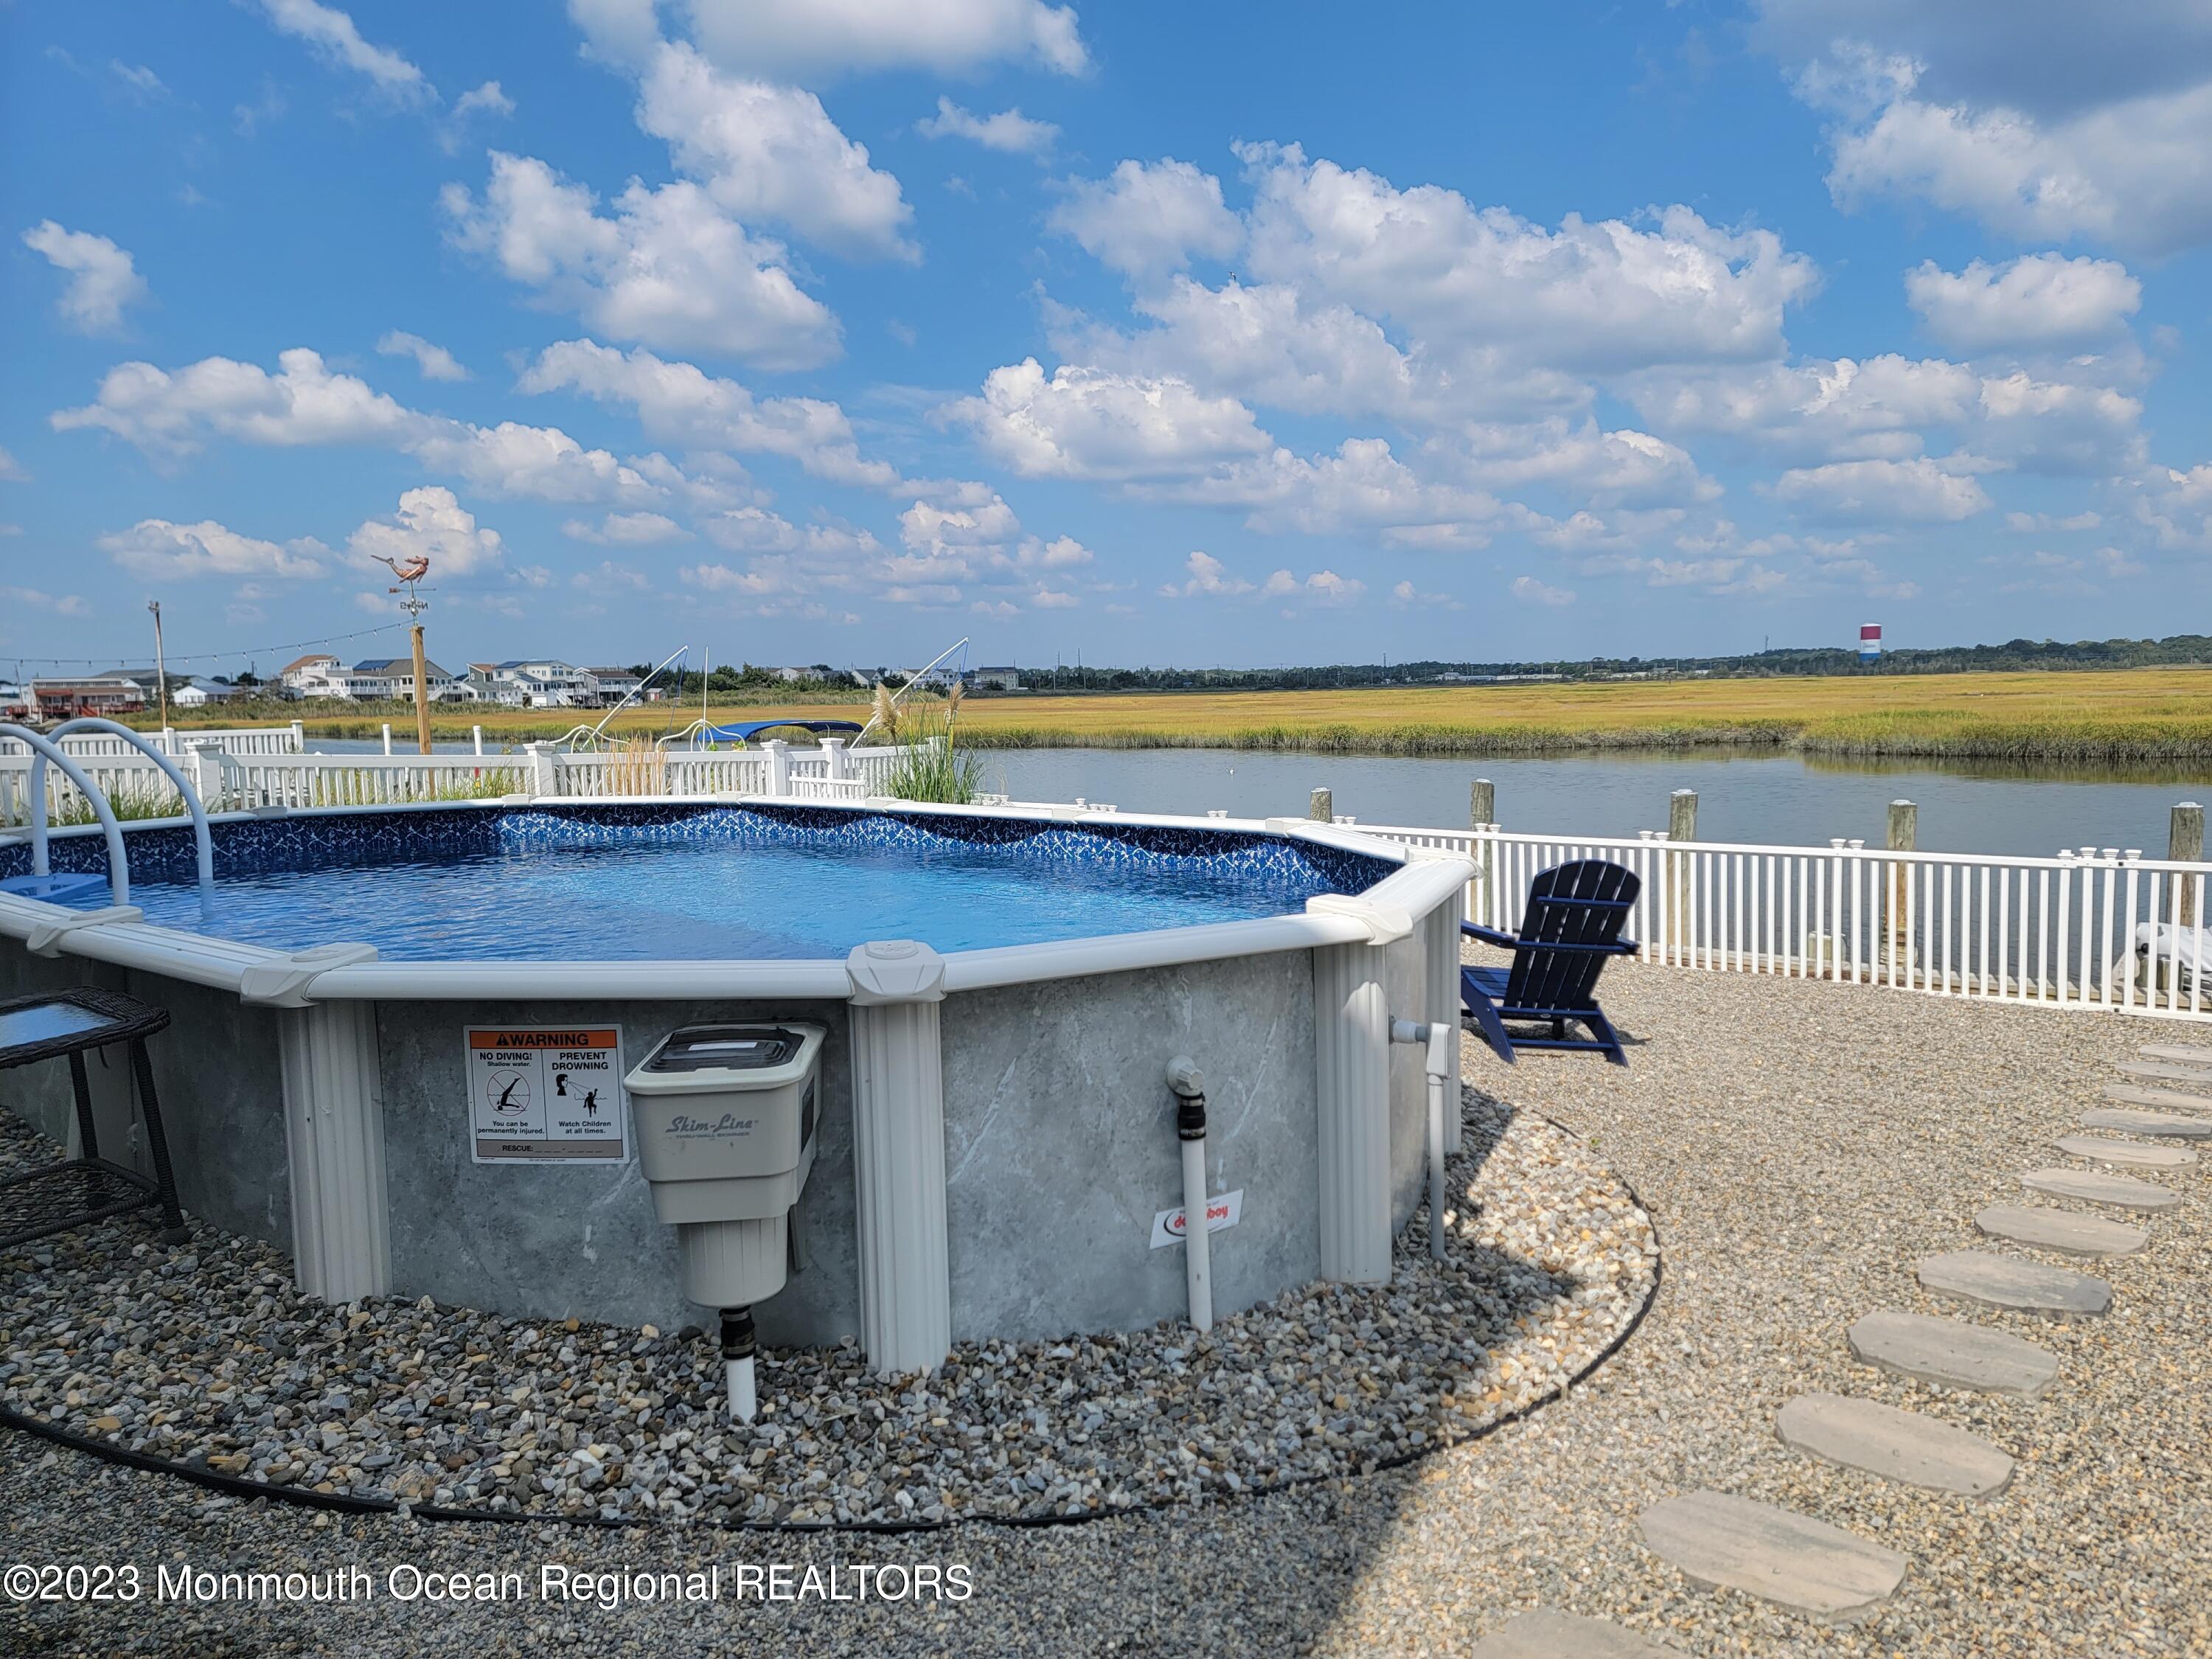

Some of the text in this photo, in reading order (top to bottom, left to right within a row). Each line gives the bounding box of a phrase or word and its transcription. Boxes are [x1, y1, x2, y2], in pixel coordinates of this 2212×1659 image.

[509, 1033, 589, 1046] WARNING
[479, 1052, 532, 1060] NO DIVING!
[560, 1051, 607, 1060] PREVENT
[552, 1062, 608, 1071] DROWNING
[665, 1113, 752, 1133] Skim-Line
